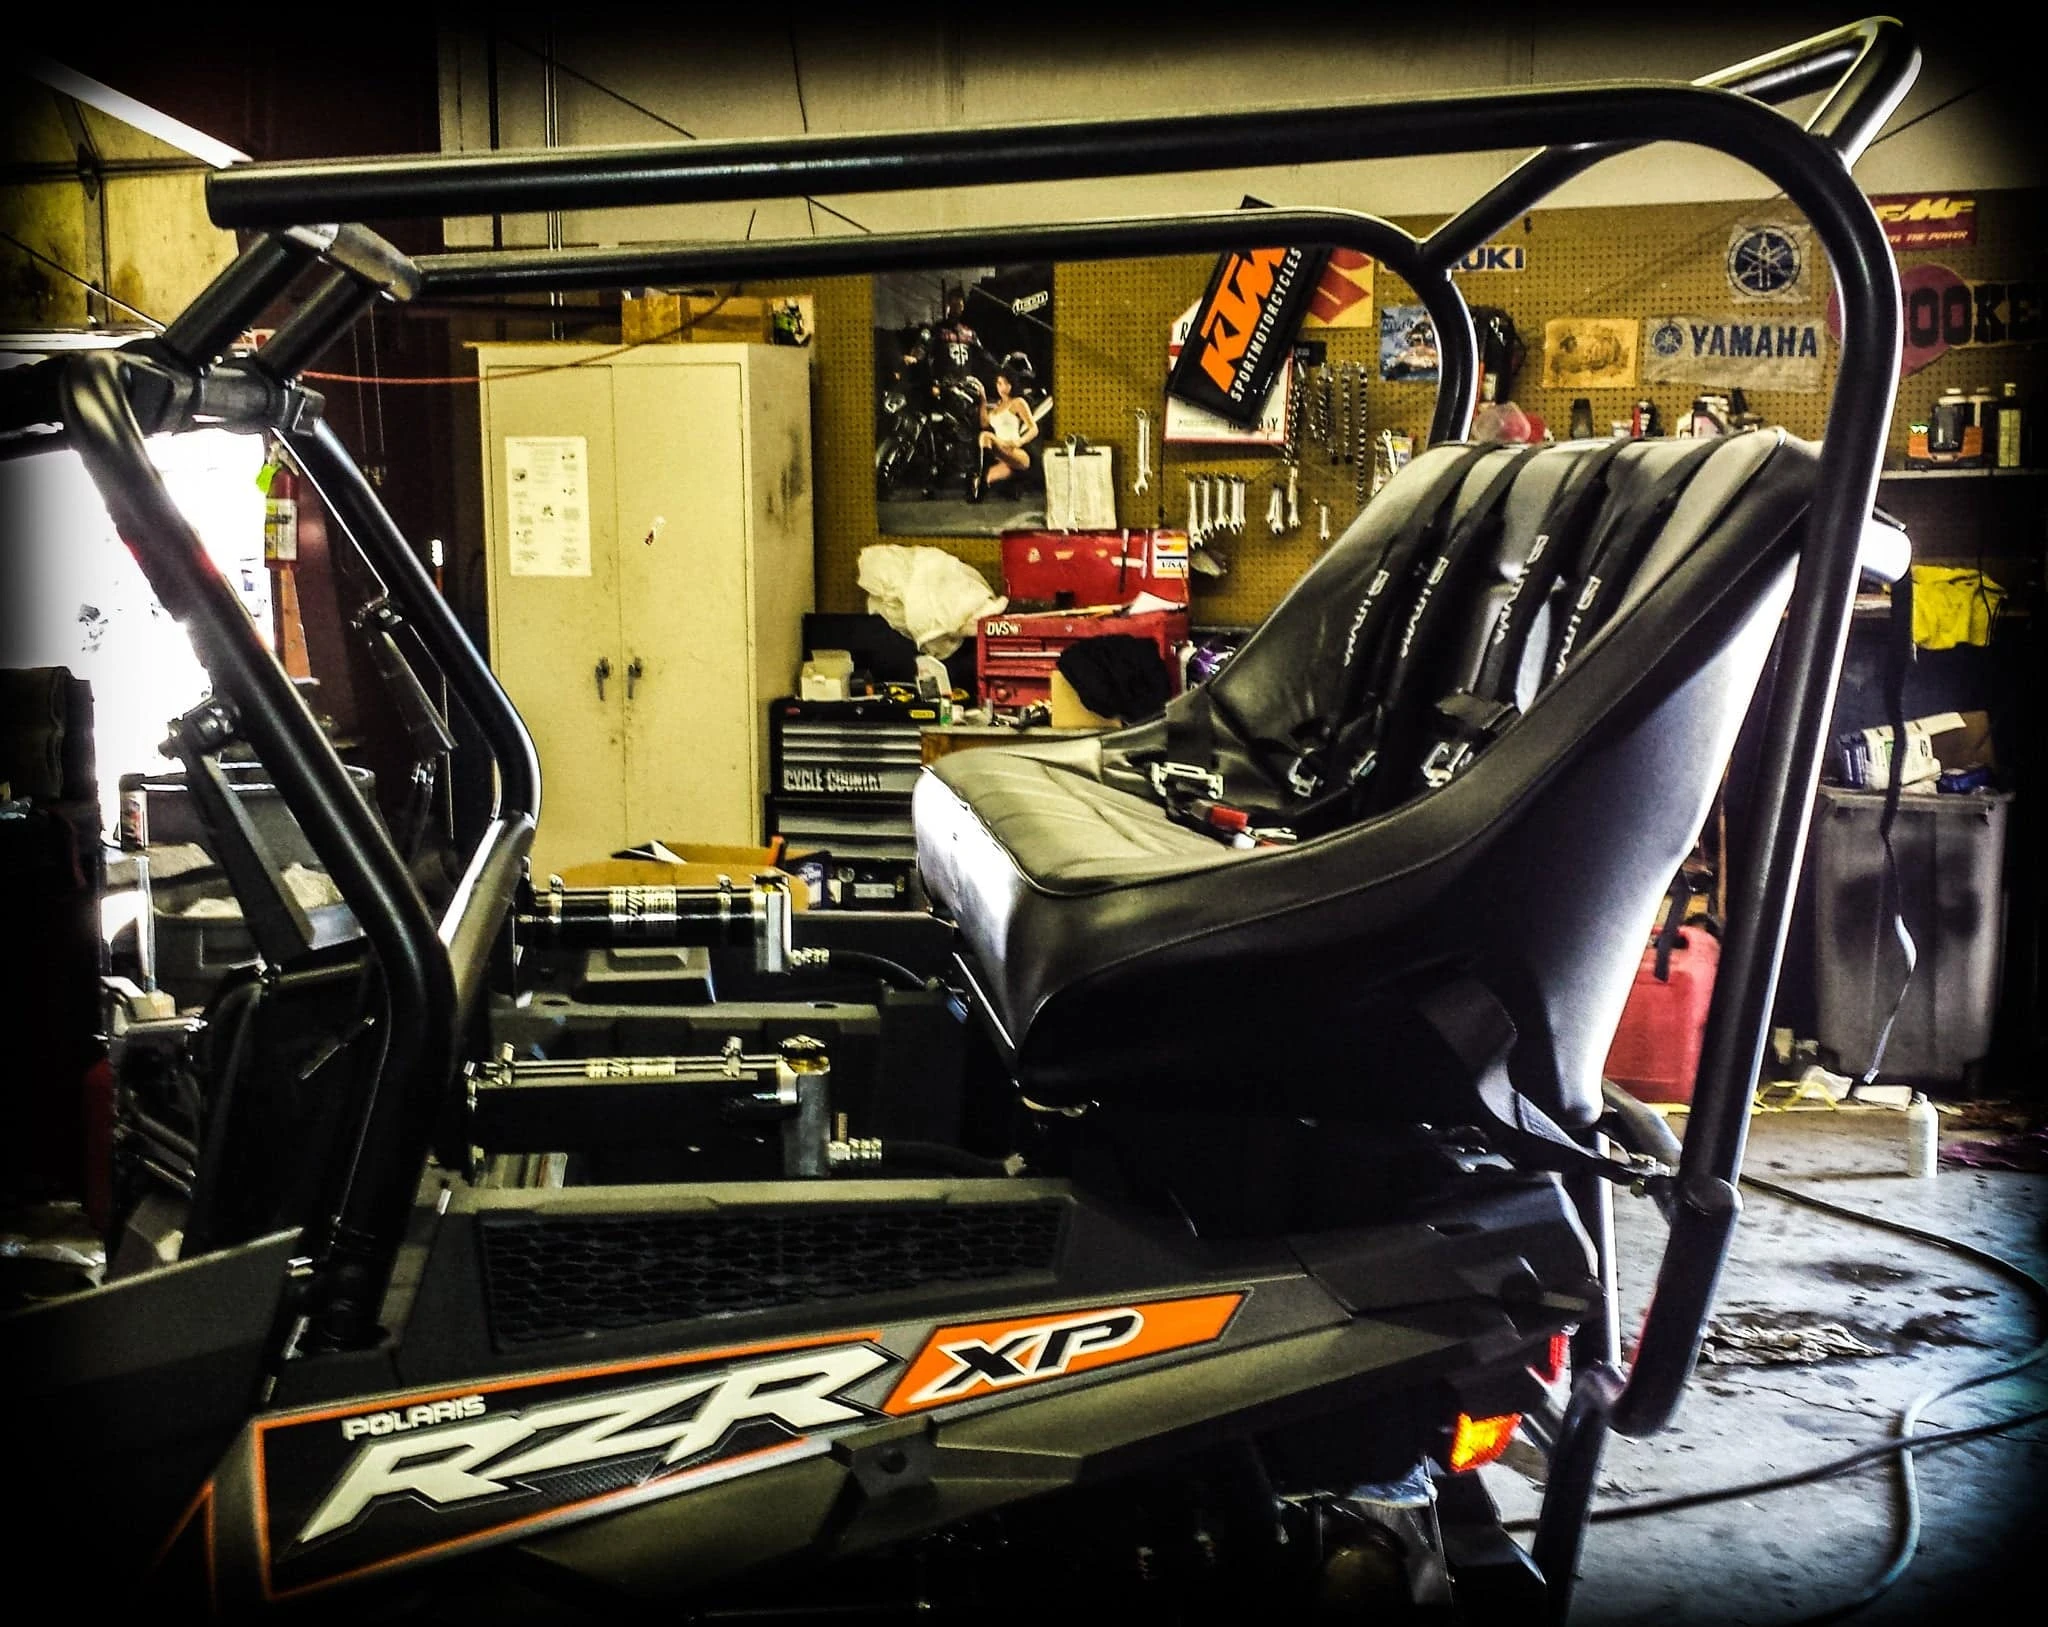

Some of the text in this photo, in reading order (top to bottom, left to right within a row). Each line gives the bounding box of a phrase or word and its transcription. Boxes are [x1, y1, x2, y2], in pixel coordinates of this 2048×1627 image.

[1875, 198, 1976, 222] FMF
[1455, 246, 1525, 270] UKI
[1200, 248, 1287, 395] KTM
[1230, 247, 1303, 402] SPORTMOTORCYCLES
[1690, 324, 1817, 358] YAMAHA
[909, 1308, 1144, 1403] XP
[301, 1344, 888, 1542] RZR
[341, 1394, 487, 1440] POLARIS
